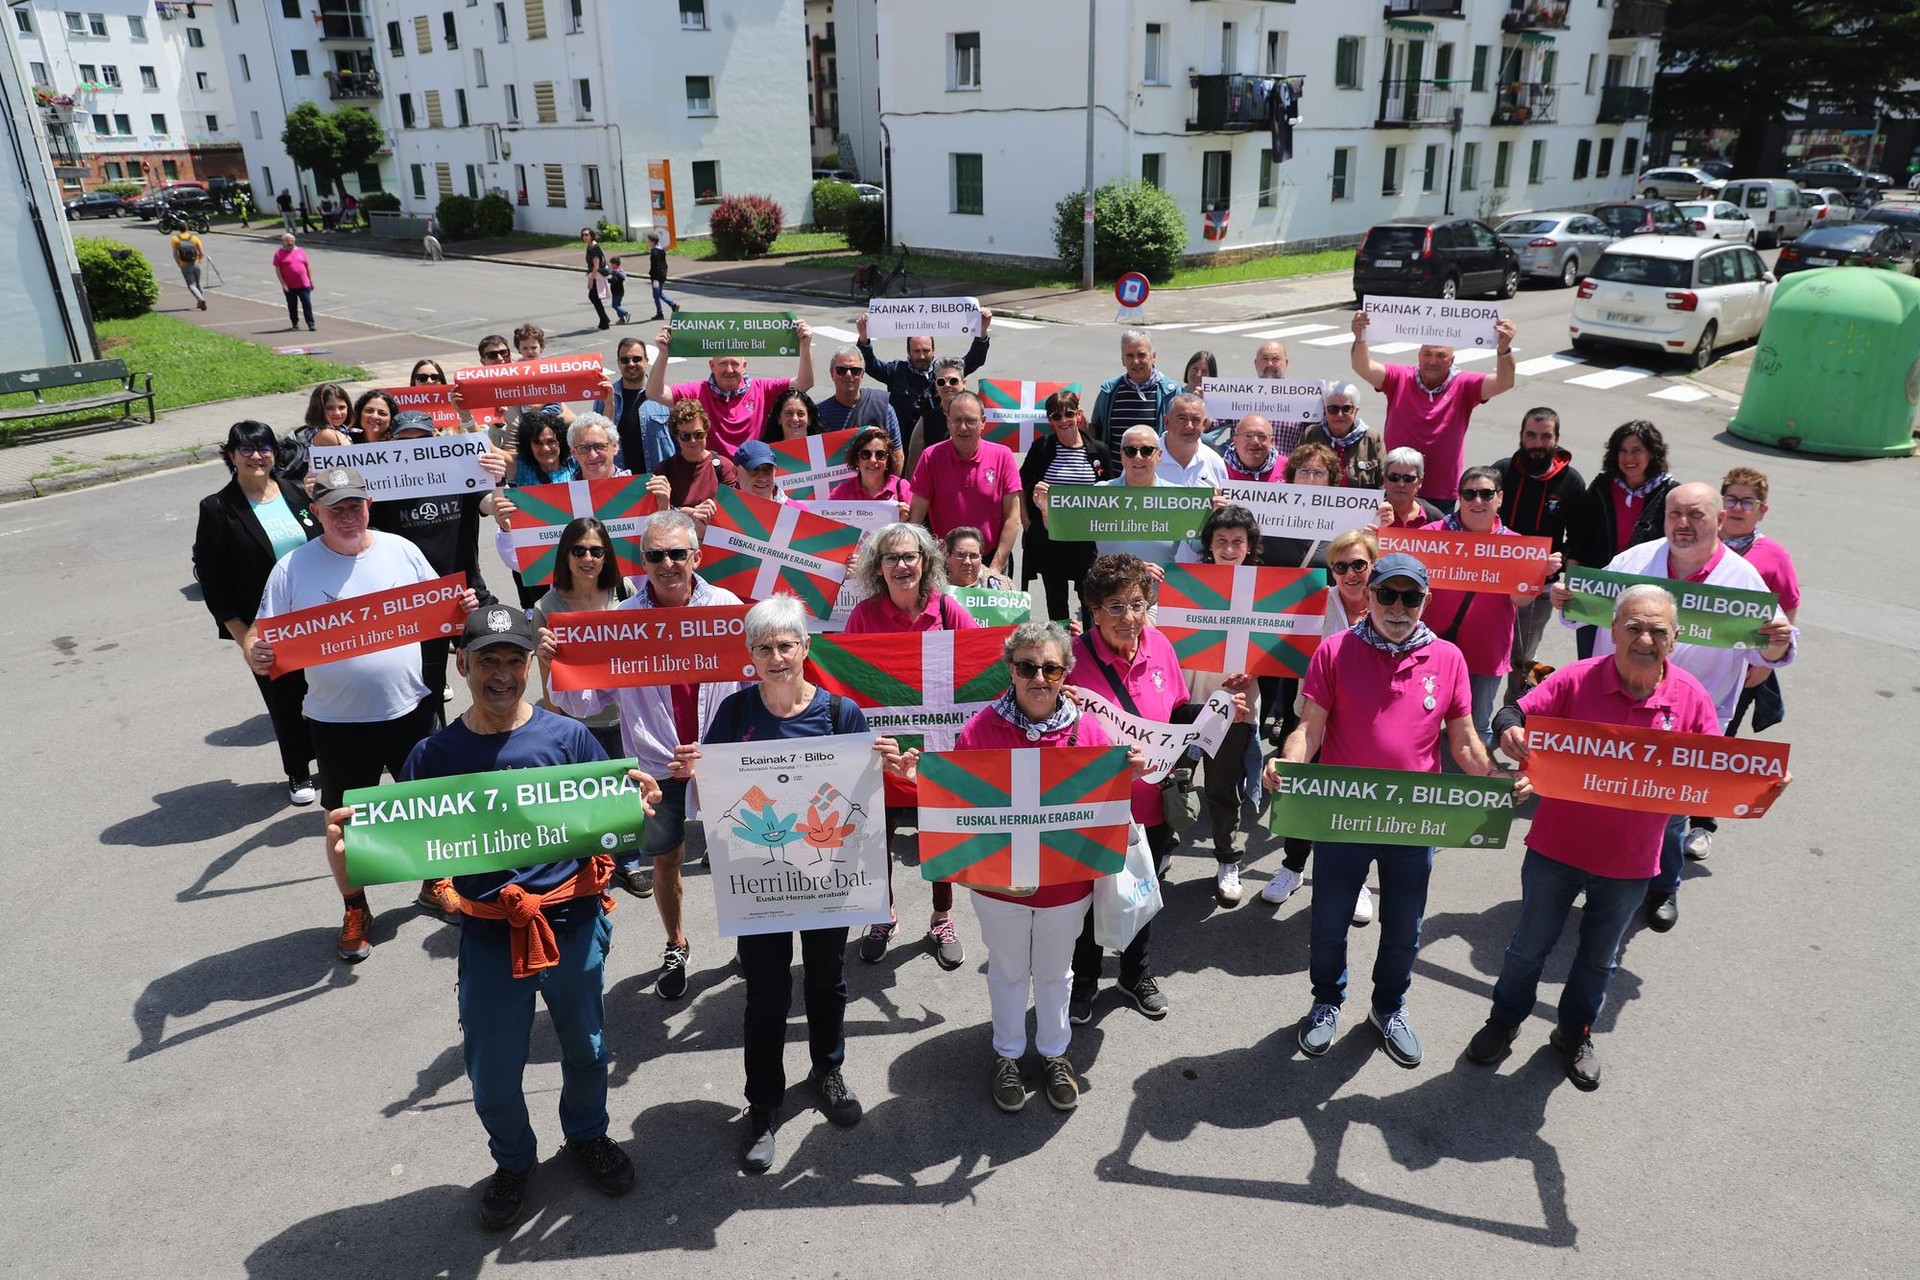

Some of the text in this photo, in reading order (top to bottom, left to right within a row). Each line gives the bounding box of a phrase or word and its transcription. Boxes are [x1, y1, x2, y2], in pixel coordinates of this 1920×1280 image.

[869, 303, 979, 315] EKAINAK 7, BILBORA
[1364, 302, 1500, 320] EKAINAK 7, BILBORA
[671, 319, 798, 332] EKAINAK 7, BILBORA
[895, 320, 950, 331] Herri Libre Bat
[1395, 324, 1461, 339] Herri Libre Bat
[702, 338, 767, 350] Herri Libre Bat
[456, 360, 602, 381] EKAINAK 7, BILBORA
[495, 382, 567, 399] Herri Libre Bat
[1203, 383, 1322, 396] EKAINAK 7, BILBORA
[393, 393, 430, 405] AINAK
[433, 393, 445, 405] 7,
[1231, 401, 1291, 413] Herri Libre Bat
[433, 411, 455, 421] Libre
[313, 441, 487, 470] EKAINAK 7, BILBORA
[394, 473, 424, 488] Libre
[427, 471, 447, 486] Bat
[1051, 496, 1213, 511] EKAINAK 7, BILBORA
[1221, 488, 1379, 511] EKAINAK 7, BILBORA
[1090, 520, 1169, 532] Herri Libre Bat
[1257, 514, 1335, 531] Herri Libre Bat
[539, 523, 635, 540] EUSKA RABAKI
[728, 536, 822, 570] EUSKAL HERRIAK ERABAKI
[1378, 537, 1548, 561] EKAINAK 7, BILBORA
[1427, 566, 1500, 583] erri Libre Bat
[966, 595, 1028, 608] BILBORA
[1568, 577, 1773, 621] EKAIN BILBORA
[263, 584, 465, 644] EKAINAK 7, BILBORA
[1186, 614, 1295, 628] EUSKAL HERRIAK ERABAKI
[320, 621, 420, 656] Herri Libre Bat
[553, 618, 745, 644] EKAINAK 7, BILBO
[1688, 624, 1713, 641] Bat
[610, 653, 719, 674] Herri Libre Bat
[866, 712, 964, 728] ERRIAK ERABAKI
[1159, 733, 1175, 750] 7,
[741, 752, 835, 765] Ekainak 7 Bilbo
[1527, 730, 1784, 778] EKAINAK 7, BILBORA
[1279, 777, 1513, 809] EKAINAK 7, BILBORA
[1582, 773, 1710, 804] Herri Libre Bat
[350, 774, 638, 827] EKAINAK 7, BILBORA
[956, 810, 1094, 826] EUSKAL HERRIAK ERABAKI
[1331, 813, 1447, 836] Herri Libre Bat
[426, 822, 569, 861] Herri Libre Bat
[729, 868, 872, 894] Herri libre bat.
[756, 890, 849, 903] Euskal Herriak erabaki
